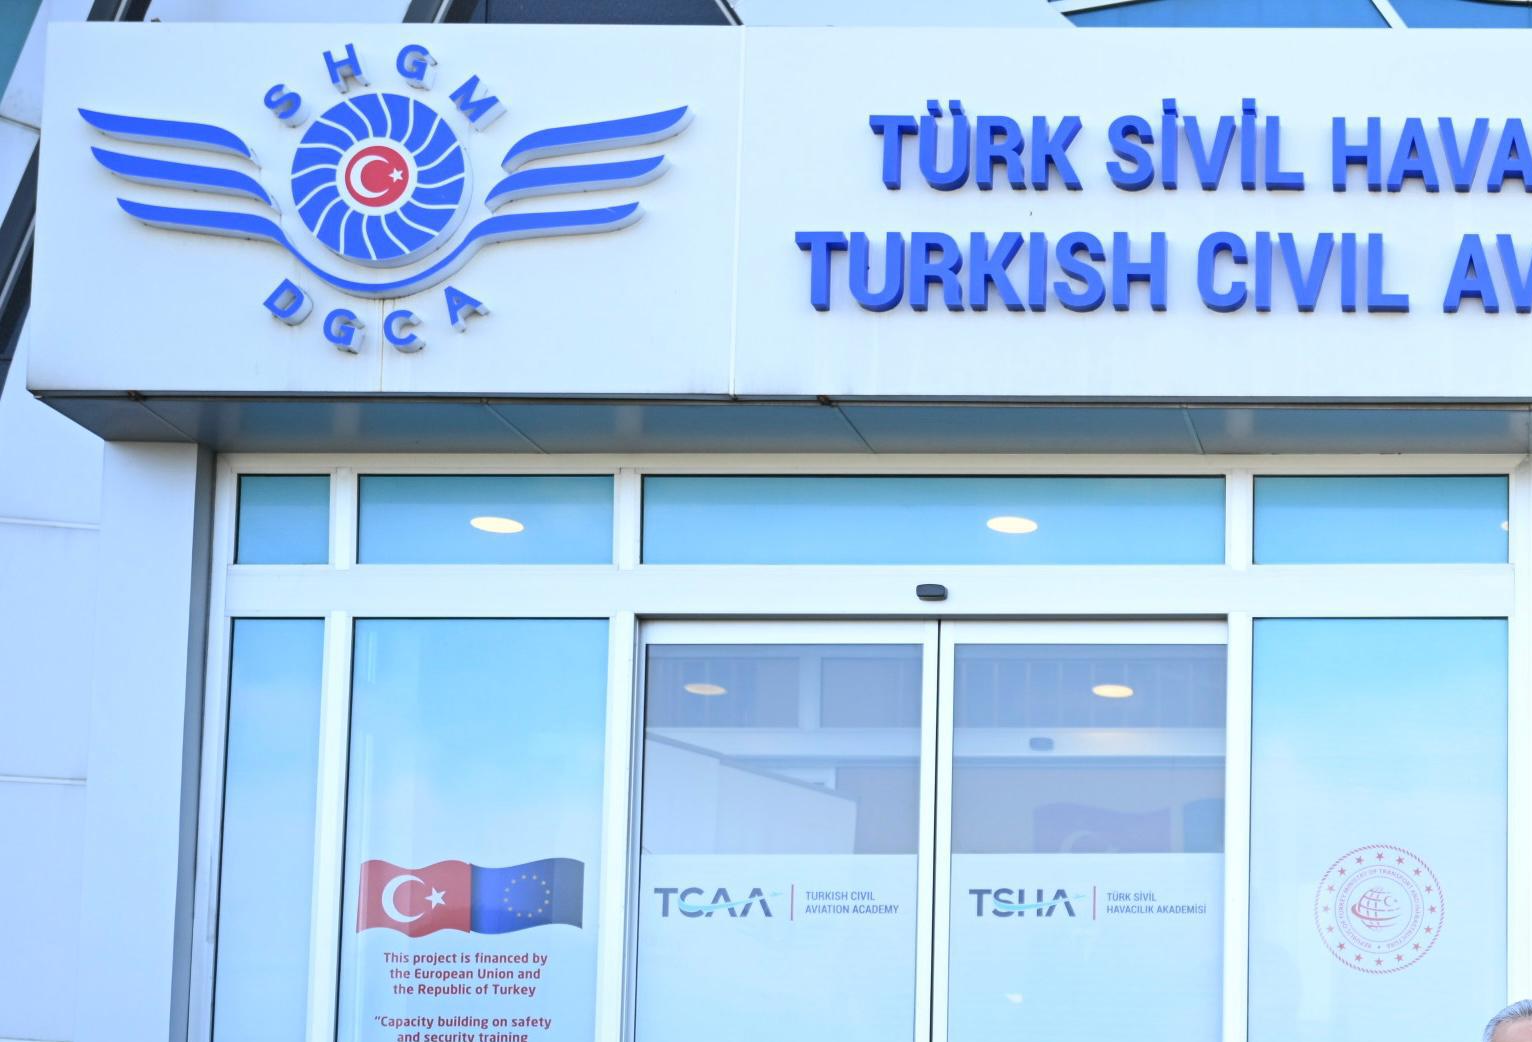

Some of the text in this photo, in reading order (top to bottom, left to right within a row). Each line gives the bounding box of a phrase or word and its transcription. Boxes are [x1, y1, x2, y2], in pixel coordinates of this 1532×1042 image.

[263, 43, 507, 132] SHGM
[869, 99, 1083, 191] TÜRK
[1106, 98, 1305, 192] SİVİL
[795, 231, 1167, 312] TURKISH
[1198, 231, 1409, 313] CIVIL
[262, 278, 489, 355] DGCA
[654, 887, 773, 918] TCAA
[805, 891, 876, 902] TURKISH CIVIL
[969, 888, 1077, 918] TSHA
[1106, 890, 1157, 902] TÜRK SİVİL
[805, 904, 899, 915] AVIATION ACADEMY
[1106, 903, 1207, 915] HAVACILIK AKADEMİSİ
[384, 952, 548, 965] This project is financed by
[390, 968, 541, 981] the European Union and
[393, 983, 536, 997] the Republic of Turkey
[438, 1016, 489, 1030] building
[492, 1018, 507, 1027] on
[511, 1016, 552, 1030] safety
[397, 1032, 420, 1042] and
